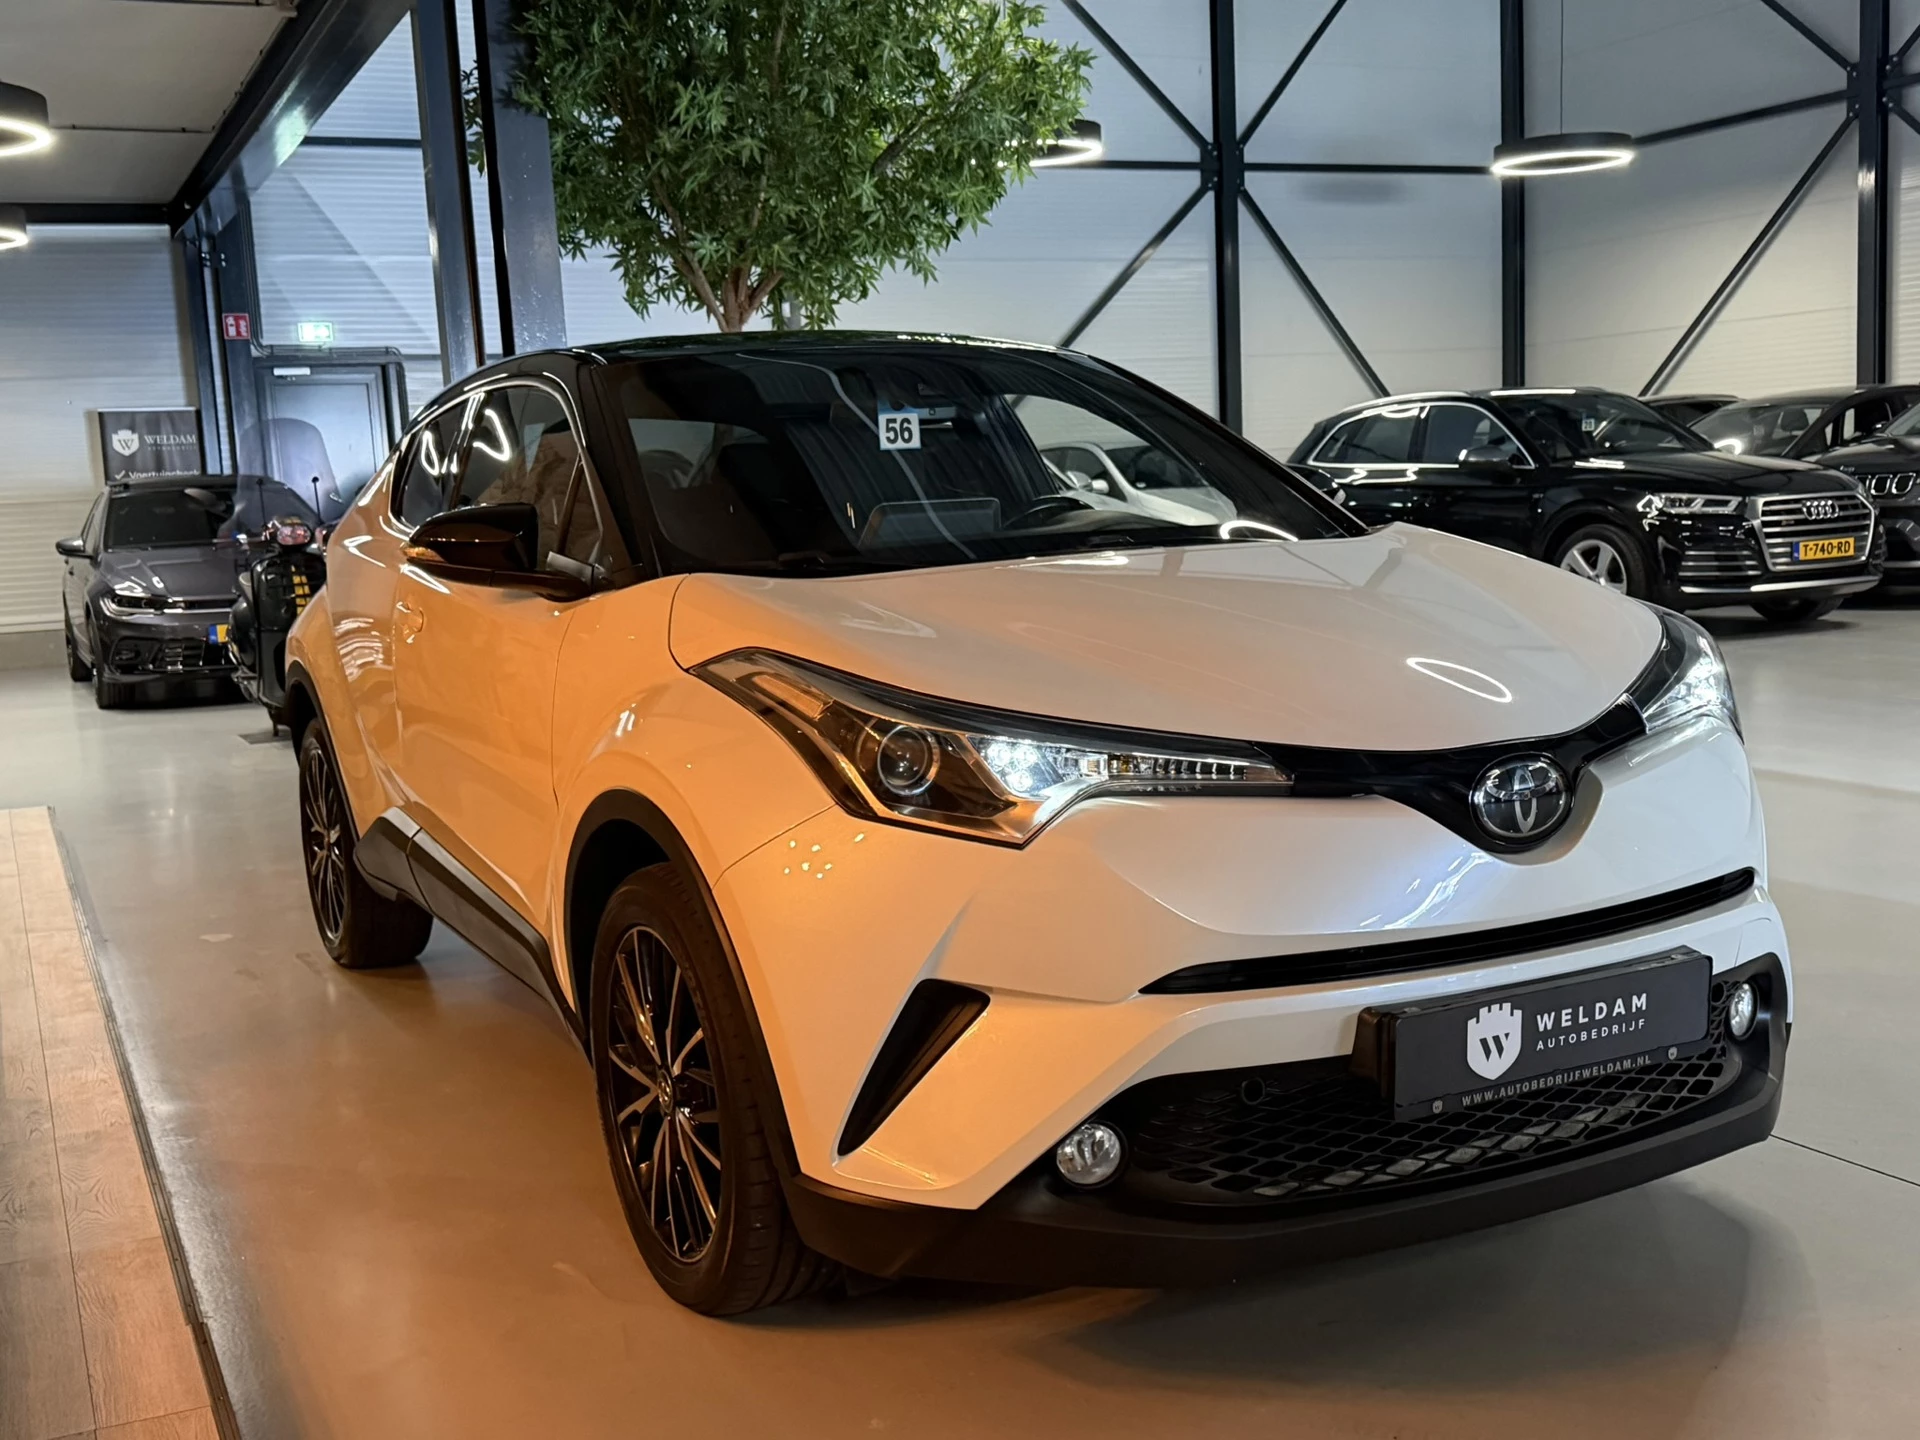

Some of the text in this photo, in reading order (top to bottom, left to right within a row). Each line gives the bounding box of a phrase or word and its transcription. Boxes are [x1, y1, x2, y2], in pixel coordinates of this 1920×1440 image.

[144, 434, 196, 445] WELDAM
[885, 417, 913, 445] 56
[1802, 540, 1851, 557] T-740-RD
[1536, 992, 1648, 1032] WELDAM
[1536, 1018, 1646, 1052] AUTOBEDRIJF
[1461, 1054, 1652, 1107] WWW.AUTOBEDRIJFWELDAM.NL
